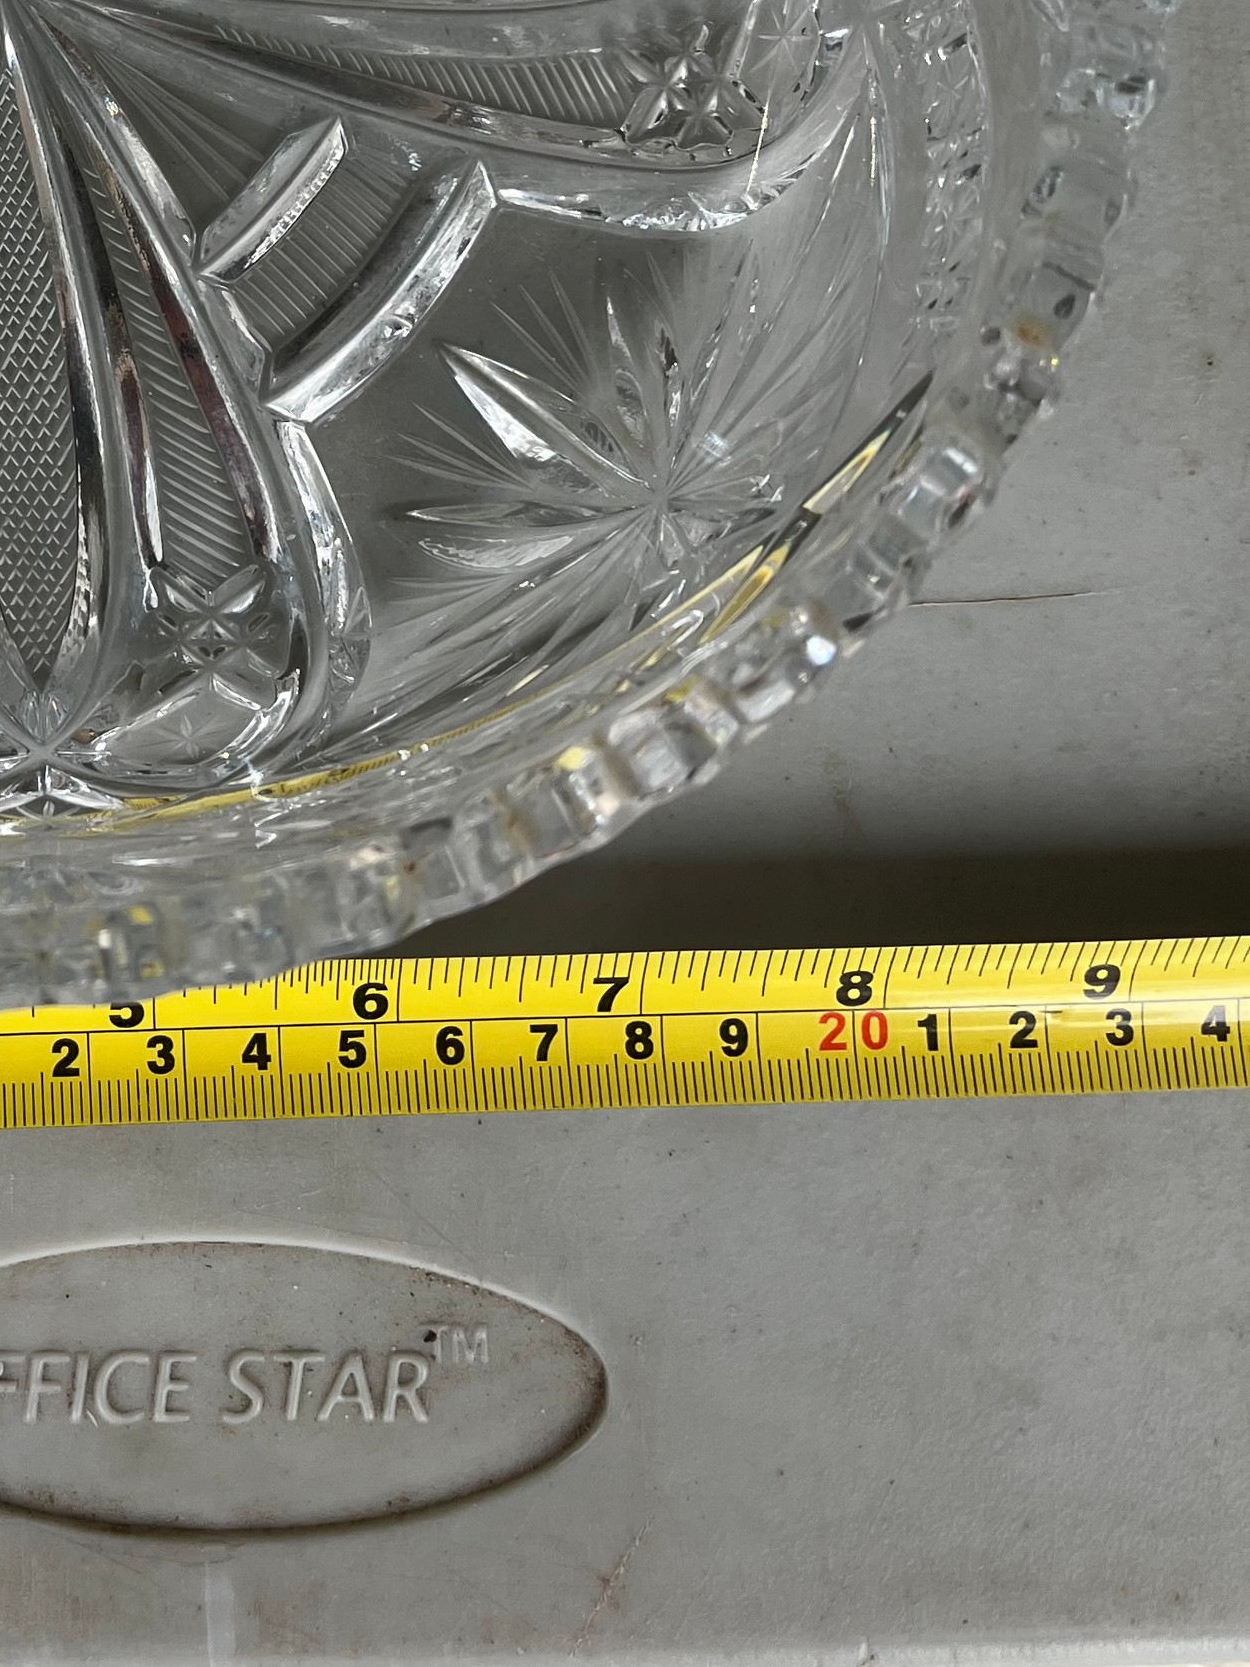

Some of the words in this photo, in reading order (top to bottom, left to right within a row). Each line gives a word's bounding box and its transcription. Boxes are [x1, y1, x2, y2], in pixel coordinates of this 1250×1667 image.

[353, 982, 389, 1019] 6
[594, 977, 629, 1012] 7
[836, 970, 873, 1006] 8
[1083, 964, 1121, 1000] 9
[51, 1038, 81, 1077] 2
[146, 1035, 176, 1075] 3
[242, 1032, 272, 1072] 4
[338, 1030, 367, 1069] 5
[436, 1026, 465, 1065] 6
[529, 1024, 559, 1062] 7
[625, 1021, 654, 1060] 8
[719, 1018, 749, 1057] 9
[818, 1011, 889, 1051] 20
[918, 1013, 938, 1052] 1
[1009, 1010, 1038, 1049] 2
[1106, 1007, 1135, 1046] 3
[1201, 1004, 1231, 1042] 4
[220, 1347, 432, 1426] STAR
